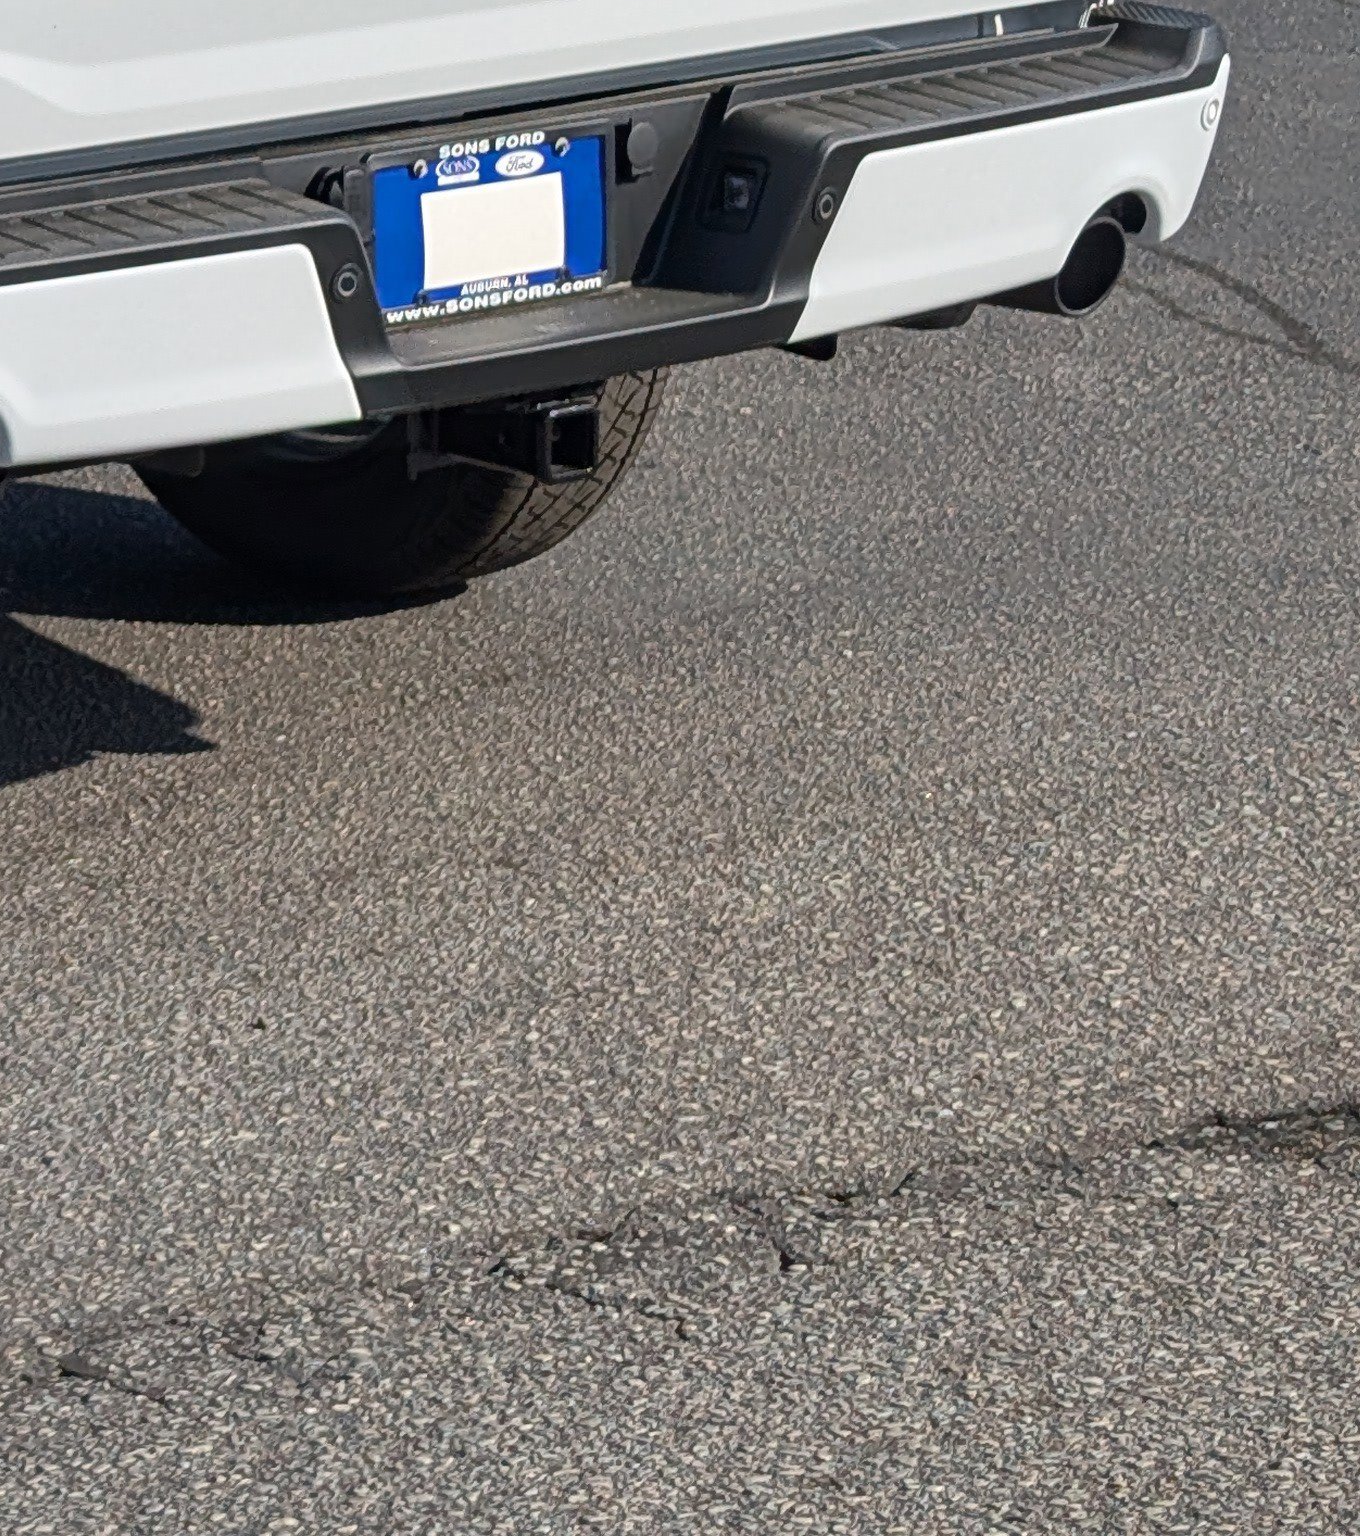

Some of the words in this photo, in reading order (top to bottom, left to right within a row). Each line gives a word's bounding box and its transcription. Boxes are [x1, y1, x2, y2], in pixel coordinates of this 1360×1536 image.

[438, 138, 490, 158] SONS
[495, 130, 546, 151] FORD
[460, 278, 512, 296] AUBURN,
[516, 275, 529, 289] AL
[386, 276, 602, 324] www.SONSFORD.com
